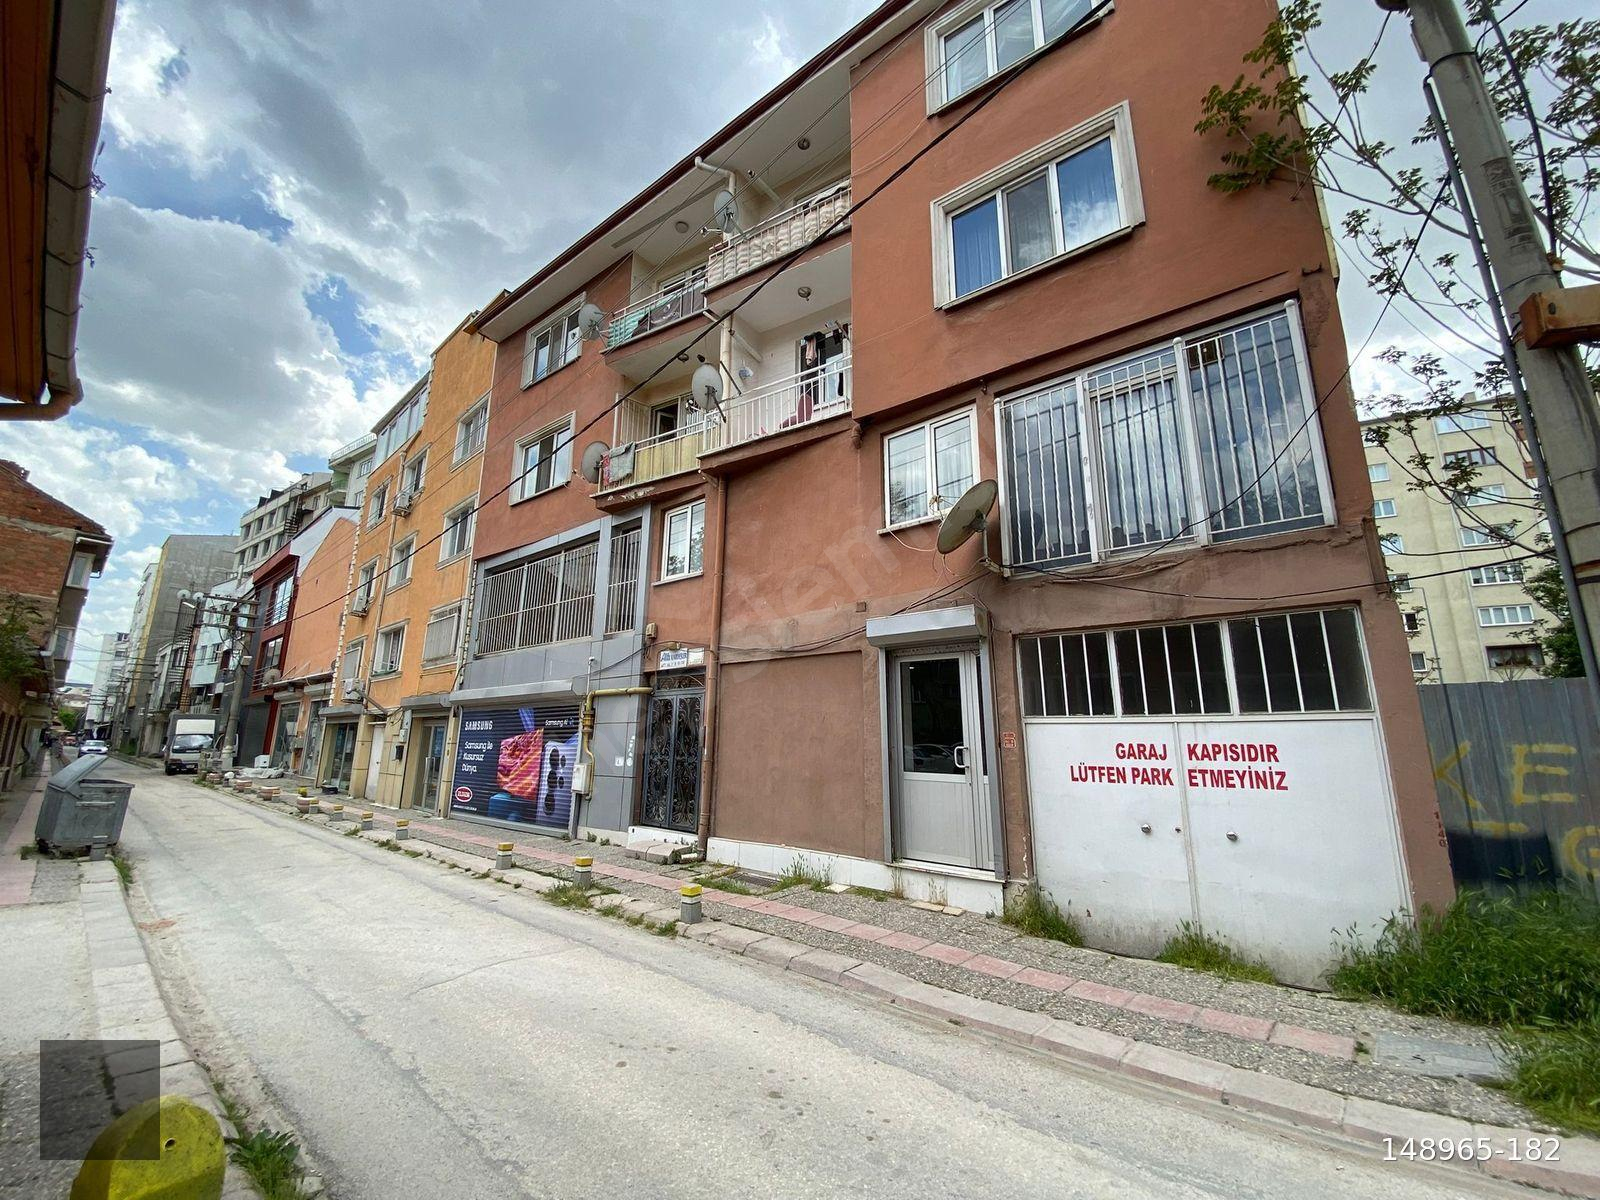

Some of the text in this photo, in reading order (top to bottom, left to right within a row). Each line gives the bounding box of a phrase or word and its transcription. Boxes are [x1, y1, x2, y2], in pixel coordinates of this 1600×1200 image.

[465, 720, 493, 730] SAMSUNG
[545, 719, 563, 727] Samsung
[464, 741, 486, 752] Samsung
[462, 752, 485, 761] Kusursuz
[1115, 742, 1280, 763] GARAJ KAPISIDIR
[461, 763, 477, 775] Dünya
[1070, 762, 1289, 791] LÜTFEN PARK ETMEYİNİZ
